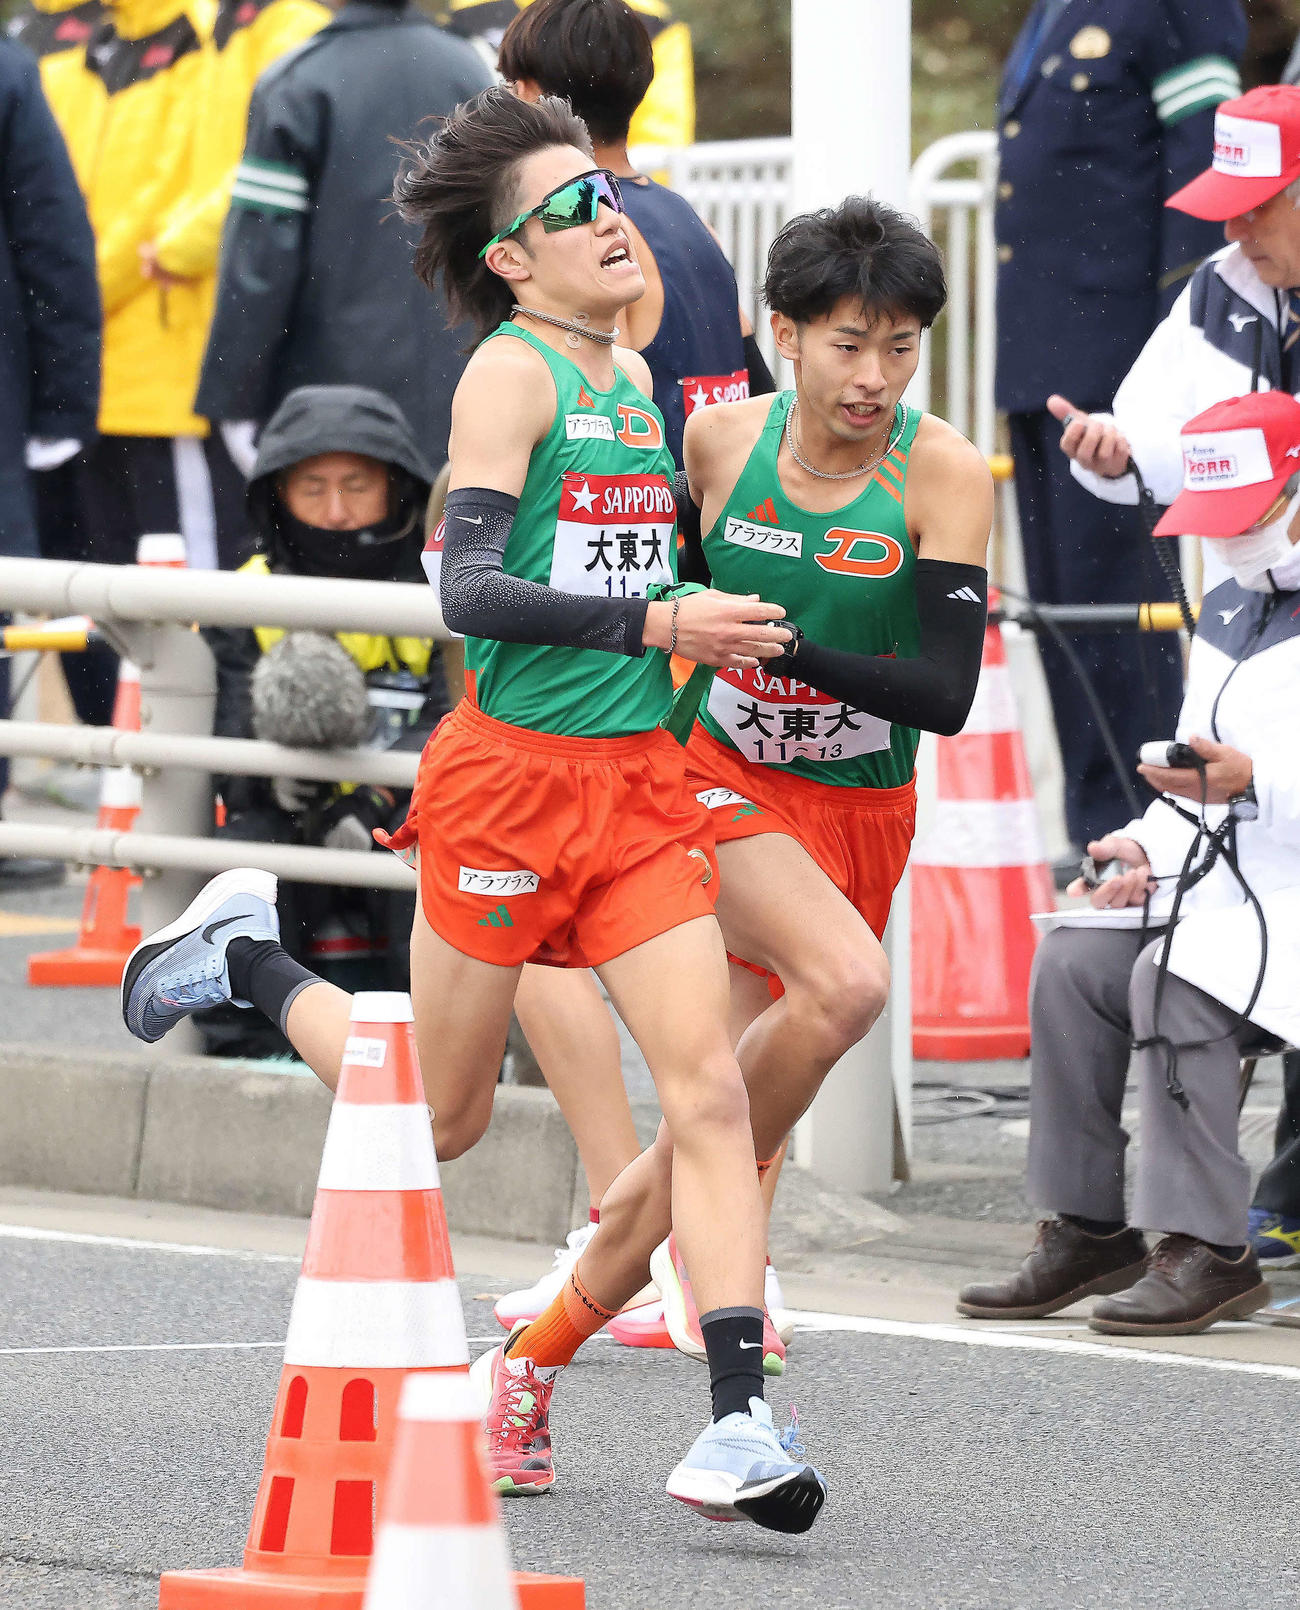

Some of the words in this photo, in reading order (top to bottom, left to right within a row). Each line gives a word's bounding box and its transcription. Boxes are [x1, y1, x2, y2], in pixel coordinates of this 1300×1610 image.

[568, 418, 613, 434] アラプラス
[602, 485, 674, 515] SAPPORO
[584, 528, 665, 572] 大東大
[728, 521, 799, 552] アラプラス
[605, 575, 650, 598] 11-
[752, 664, 818, 698] SAP
[735, 700, 863, 742] 大東大
[701, 790, 745, 806] アラ
[463, 872, 535, 892] アラプラス
